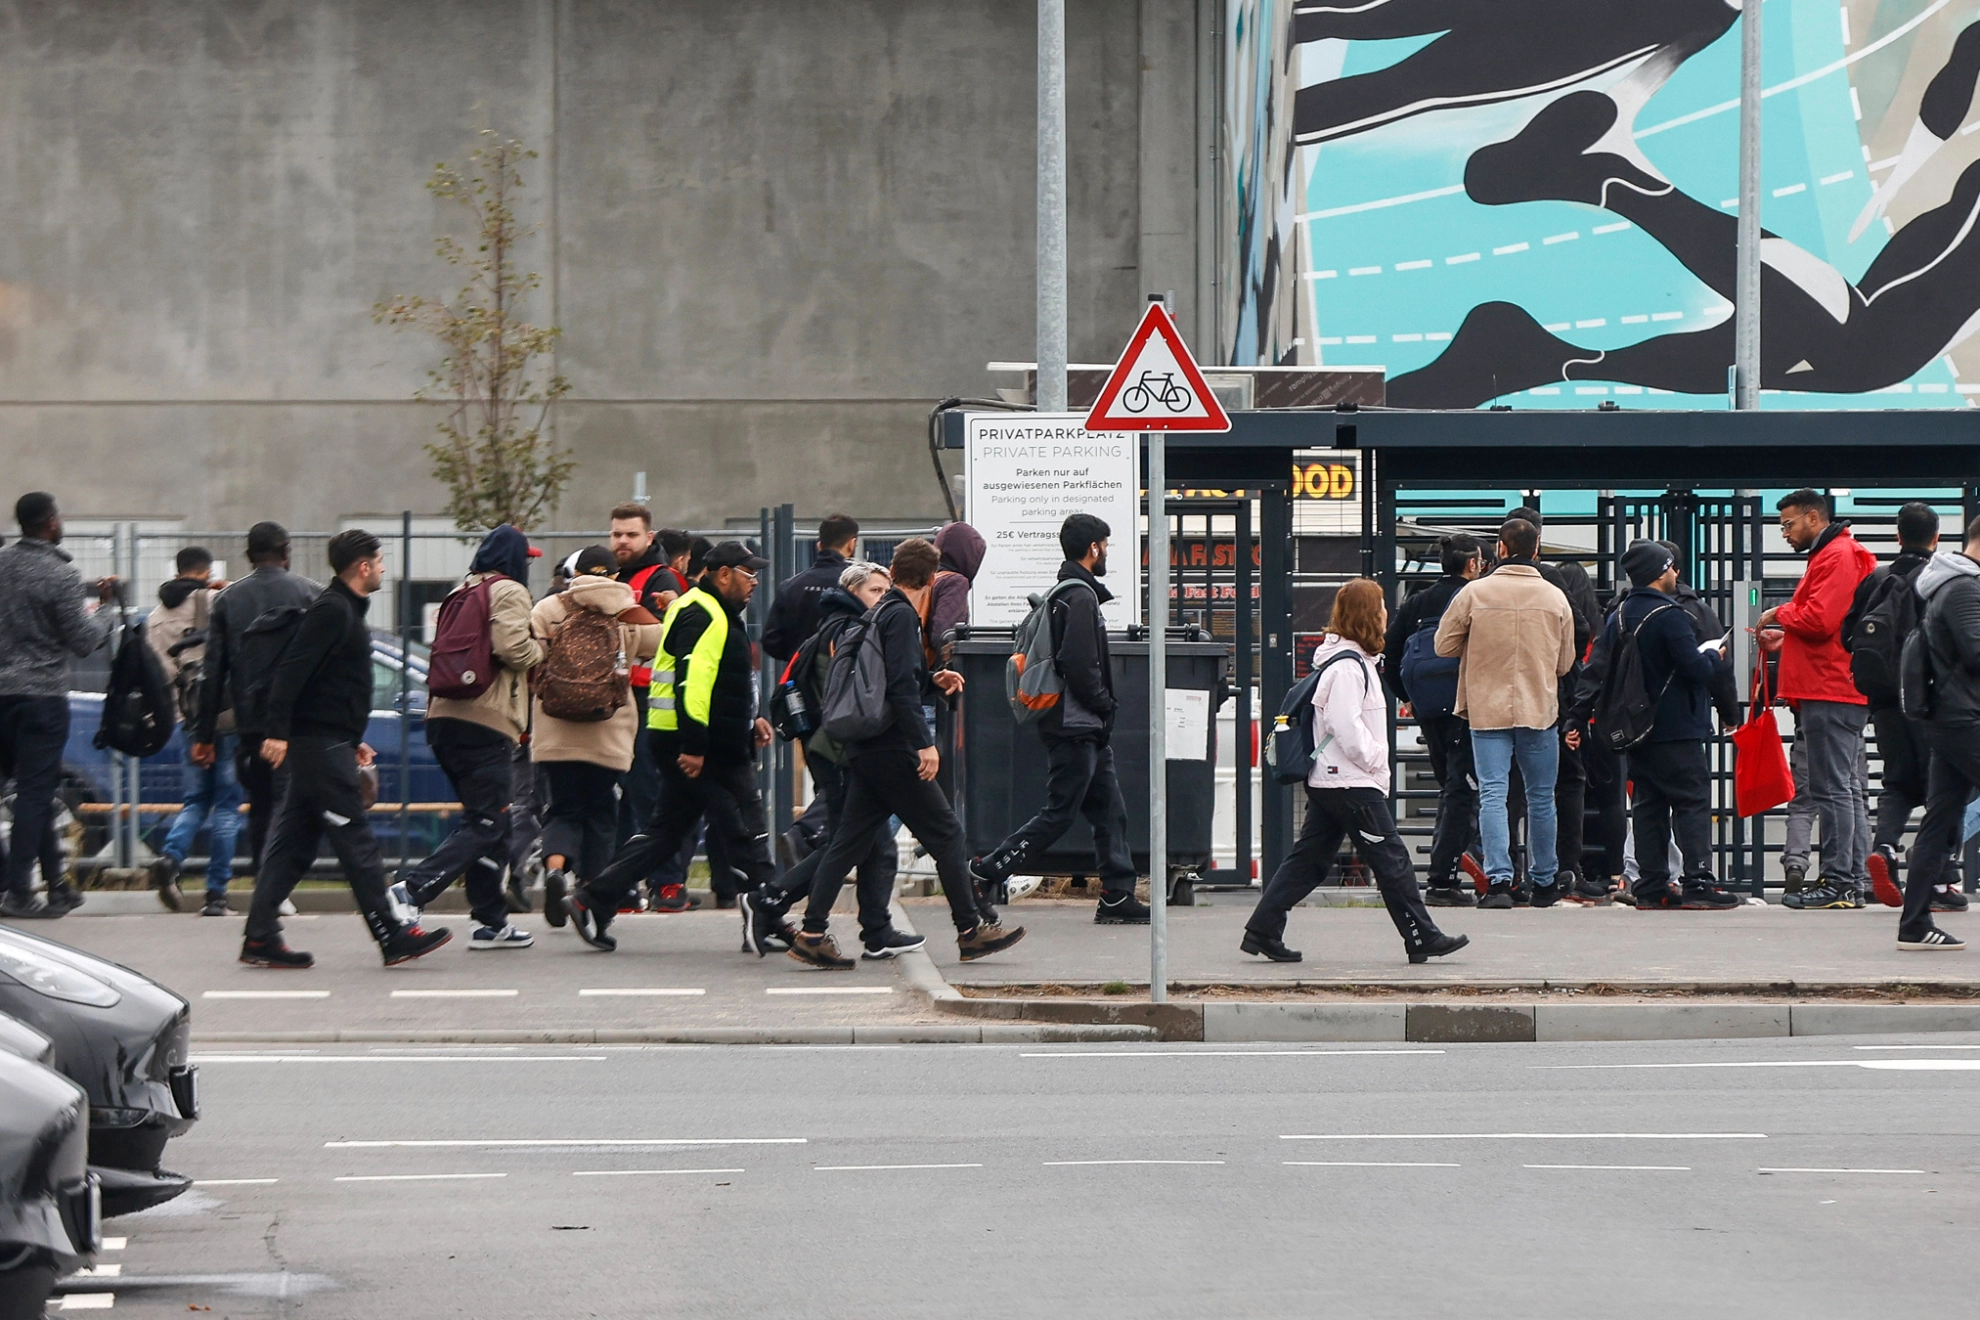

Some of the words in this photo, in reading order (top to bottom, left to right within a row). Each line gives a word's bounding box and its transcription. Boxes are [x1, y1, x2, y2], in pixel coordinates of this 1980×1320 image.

[983, 446, 1047, 458] PRIVATE
[1053, 445, 1122, 458] PARKING
[1016, 468, 1050, 477] Parken
[1053, 469, 1070, 477] nur
[1073, 467, 1089, 476] auf
[983, 480, 1060, 491] ausgewiesenen
[1063, 480, 1122, 489] Parkflächen
[991, 495, 1026, 505] Parking
[1029, 495, 1049, 505] only
[1051, 495, 1060, 503] in
[1063, 494, 1114, 504] designated
[1022, 508, 1056, 517] parking
[996, 531, 1014, 539] 25€
[1017, 531, 1061, 540] Vertragss
[1220, 585, 1260, 599] Fod
[995, 839, 1030, 870] ESLA
